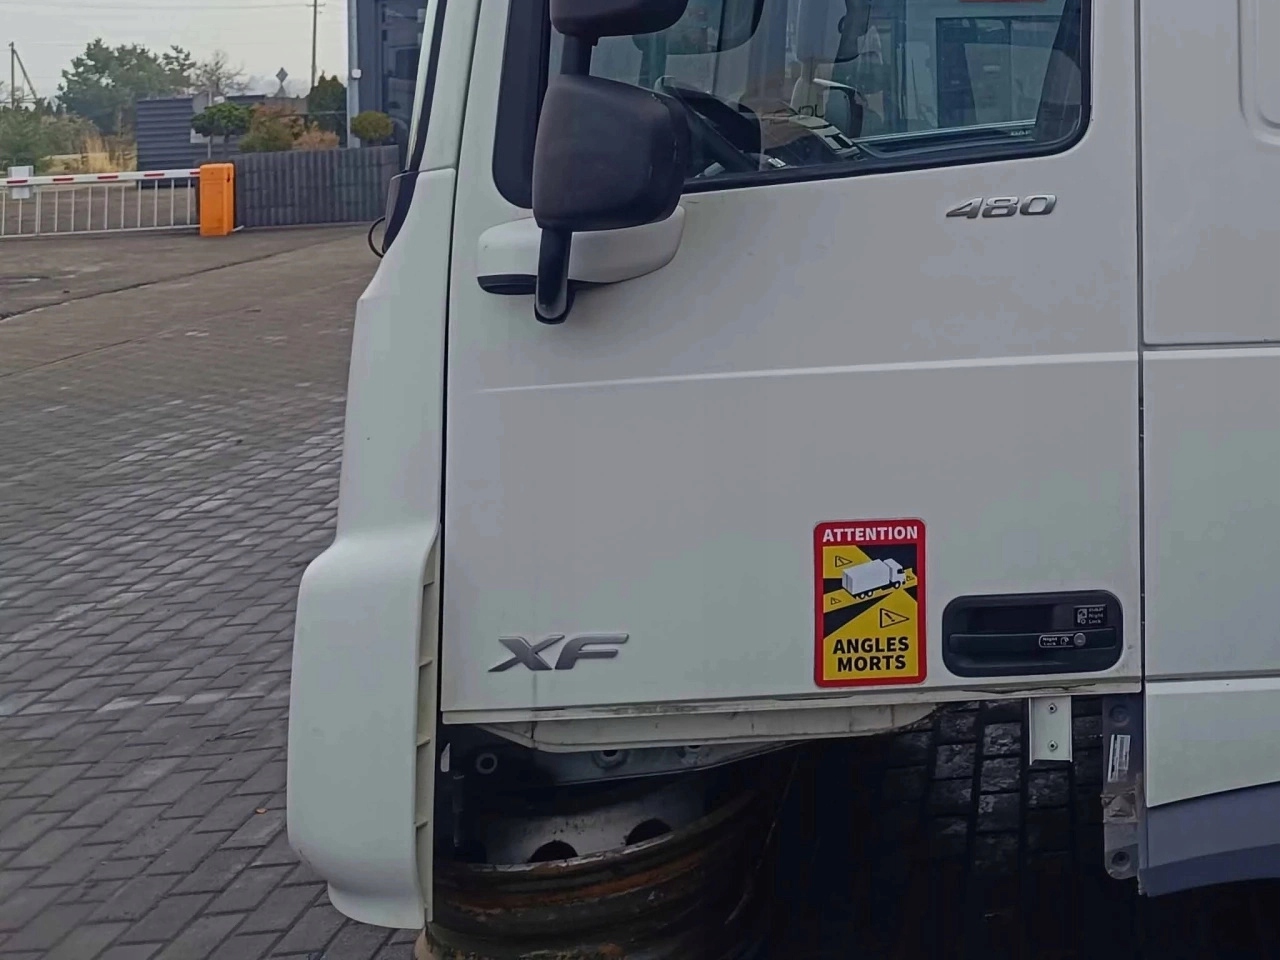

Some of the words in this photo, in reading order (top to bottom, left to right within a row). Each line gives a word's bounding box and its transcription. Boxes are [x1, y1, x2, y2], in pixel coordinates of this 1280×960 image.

[945, 194, 1058, 219] 480
[822, 525, 918, 542] ATTENTION
[487, 632, 630, 672] XF
[832, 636, 910, 655] ANGLES
[837, 654, 907, 672] MORTS
